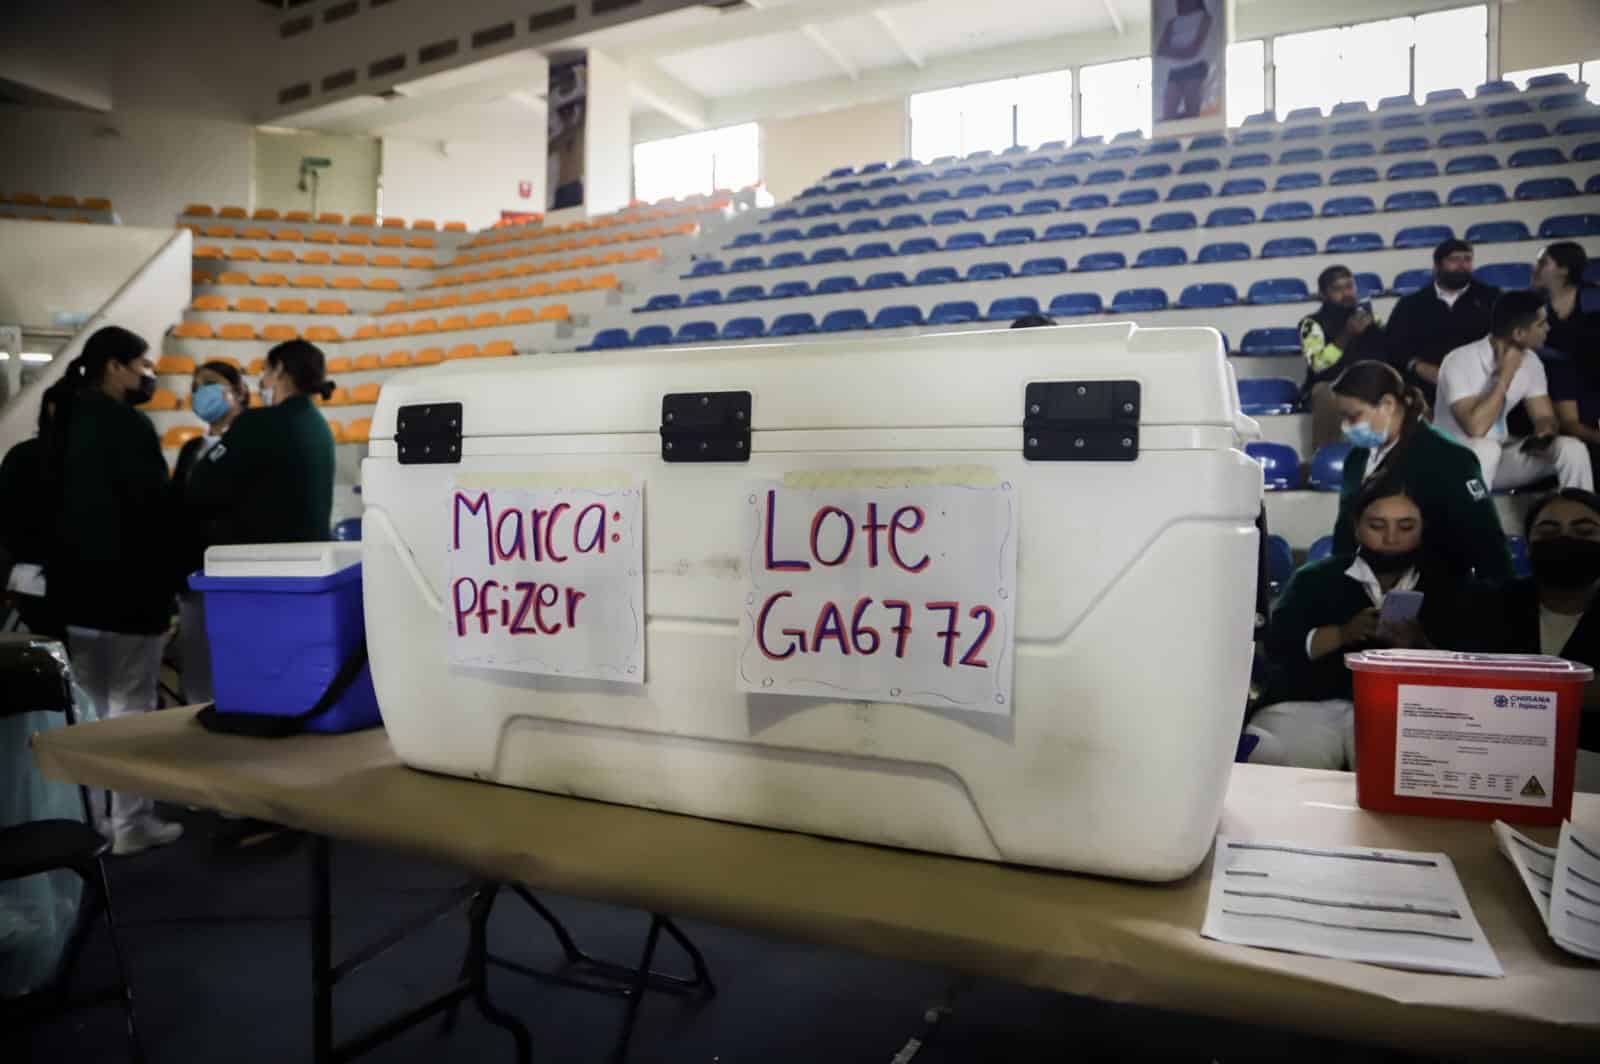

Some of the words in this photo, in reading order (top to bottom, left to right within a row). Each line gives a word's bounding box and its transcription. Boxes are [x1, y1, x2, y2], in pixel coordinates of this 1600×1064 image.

[453, 491, 621, 566] Marca:
[764, 489, 931, 574] Lote
[453, 576, 588, 637] Pfizer
[756, 590, 996, 669] GA6772
